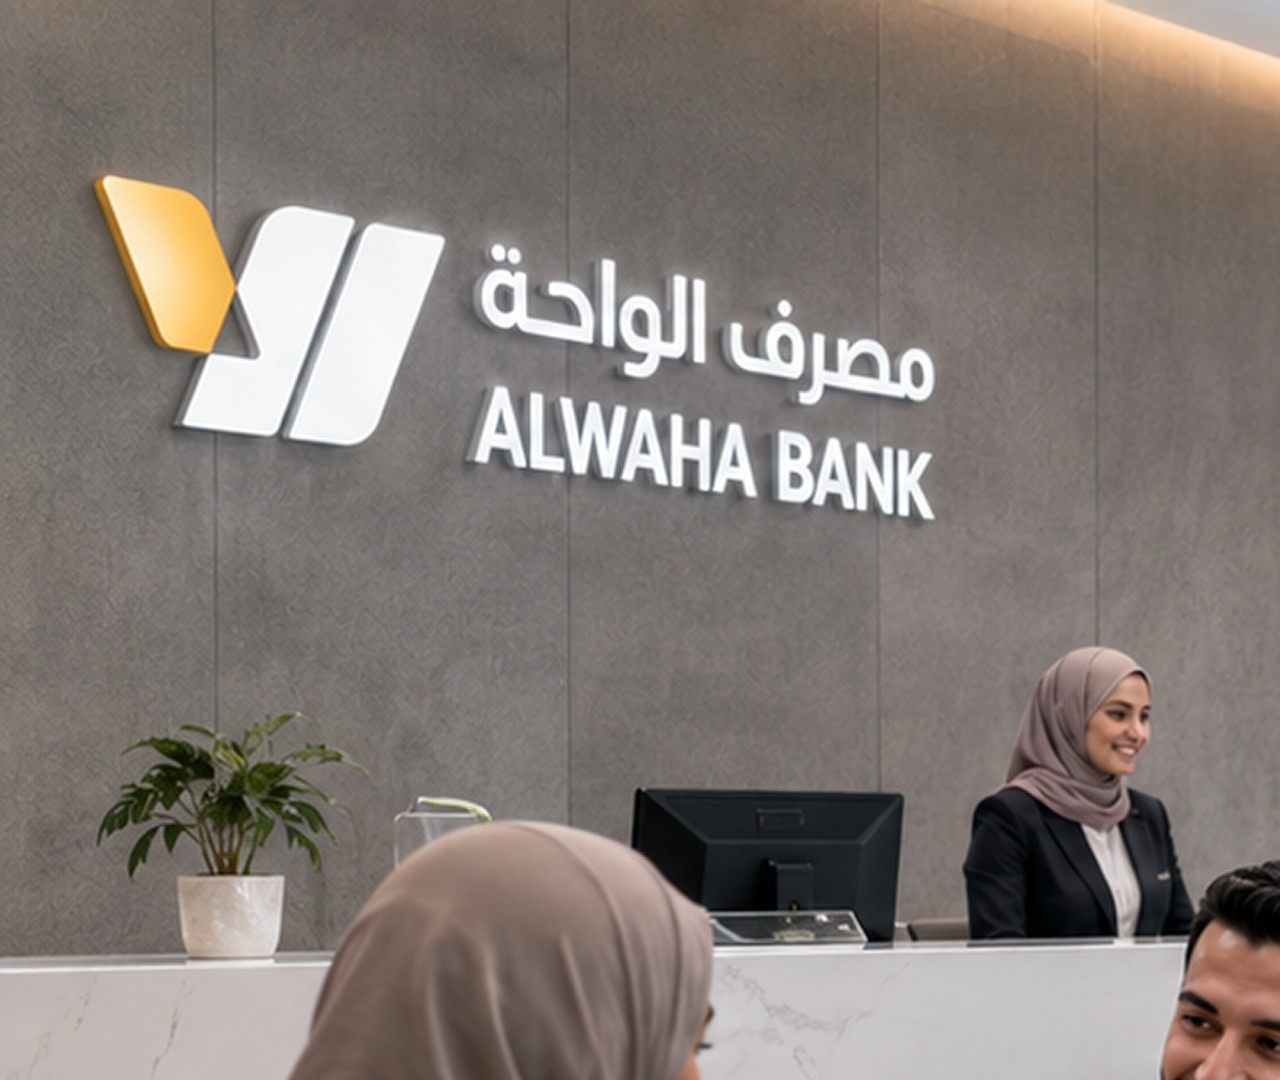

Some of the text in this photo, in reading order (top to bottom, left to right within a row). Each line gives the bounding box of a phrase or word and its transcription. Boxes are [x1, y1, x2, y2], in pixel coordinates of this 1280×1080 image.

[476, 243, 936, 406] مصرف الواحة
[471, 386, 936, 521] ALWAHA BANK
